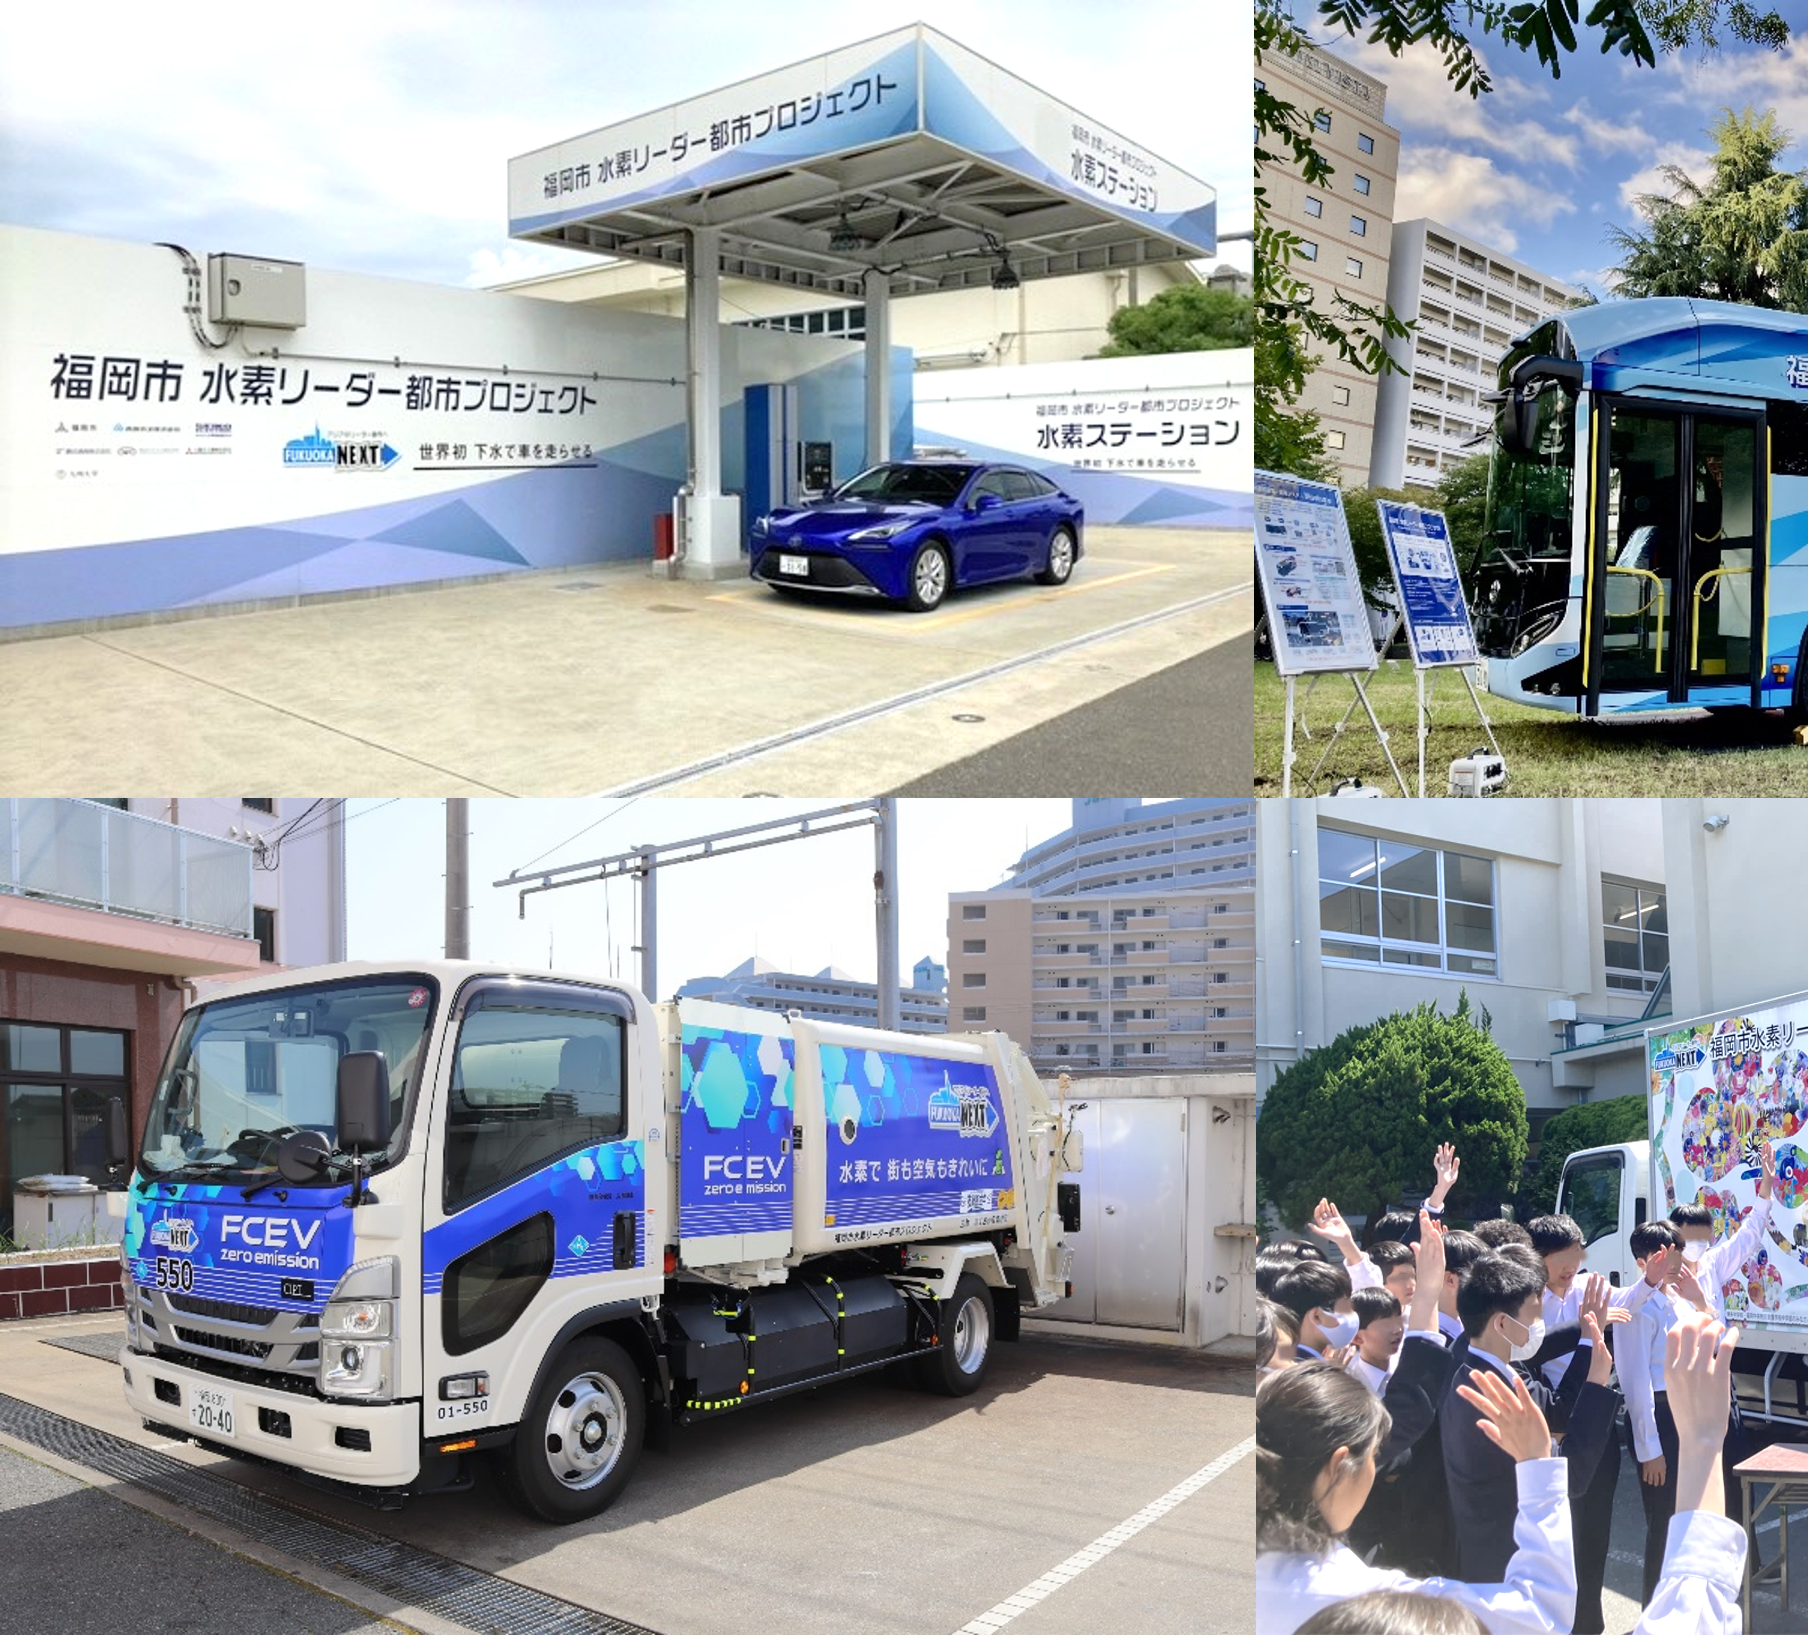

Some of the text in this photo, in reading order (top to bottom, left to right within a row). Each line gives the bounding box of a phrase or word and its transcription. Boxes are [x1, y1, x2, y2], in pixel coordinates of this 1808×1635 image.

[544, 74, 897, 199] 福岡市 水素リーダー都市プロジェクト
[1071, 148, 1158, 213] 水素ステーション
[51, 354, 597, 416] 福岡市 水素リーダー都市プロジェクト
[1037, 420, 1240, 449] 水素ステーション
[285, 445, 379, 465] FUKUOKA NEXT
[419, 443, 593, 461] 世界初 下水で車を走らせる
[1676, 1050, 1696, 1068] NEXT
[961, 1102, 985, 1128] NEXT
[704, 1155, 787, 1180] FCEV
[839, 1158, 988, 1184] 水素で 街も空気もきれいに
[220, 1215, 322, 1250] FCEV
[220, 1248, 320, 1271] zero emission
[157, 1257, 194, 1292] 550
[198, 1404, 232, 1433] 20-40
[438, 1400, 488, 1419] 01-550
